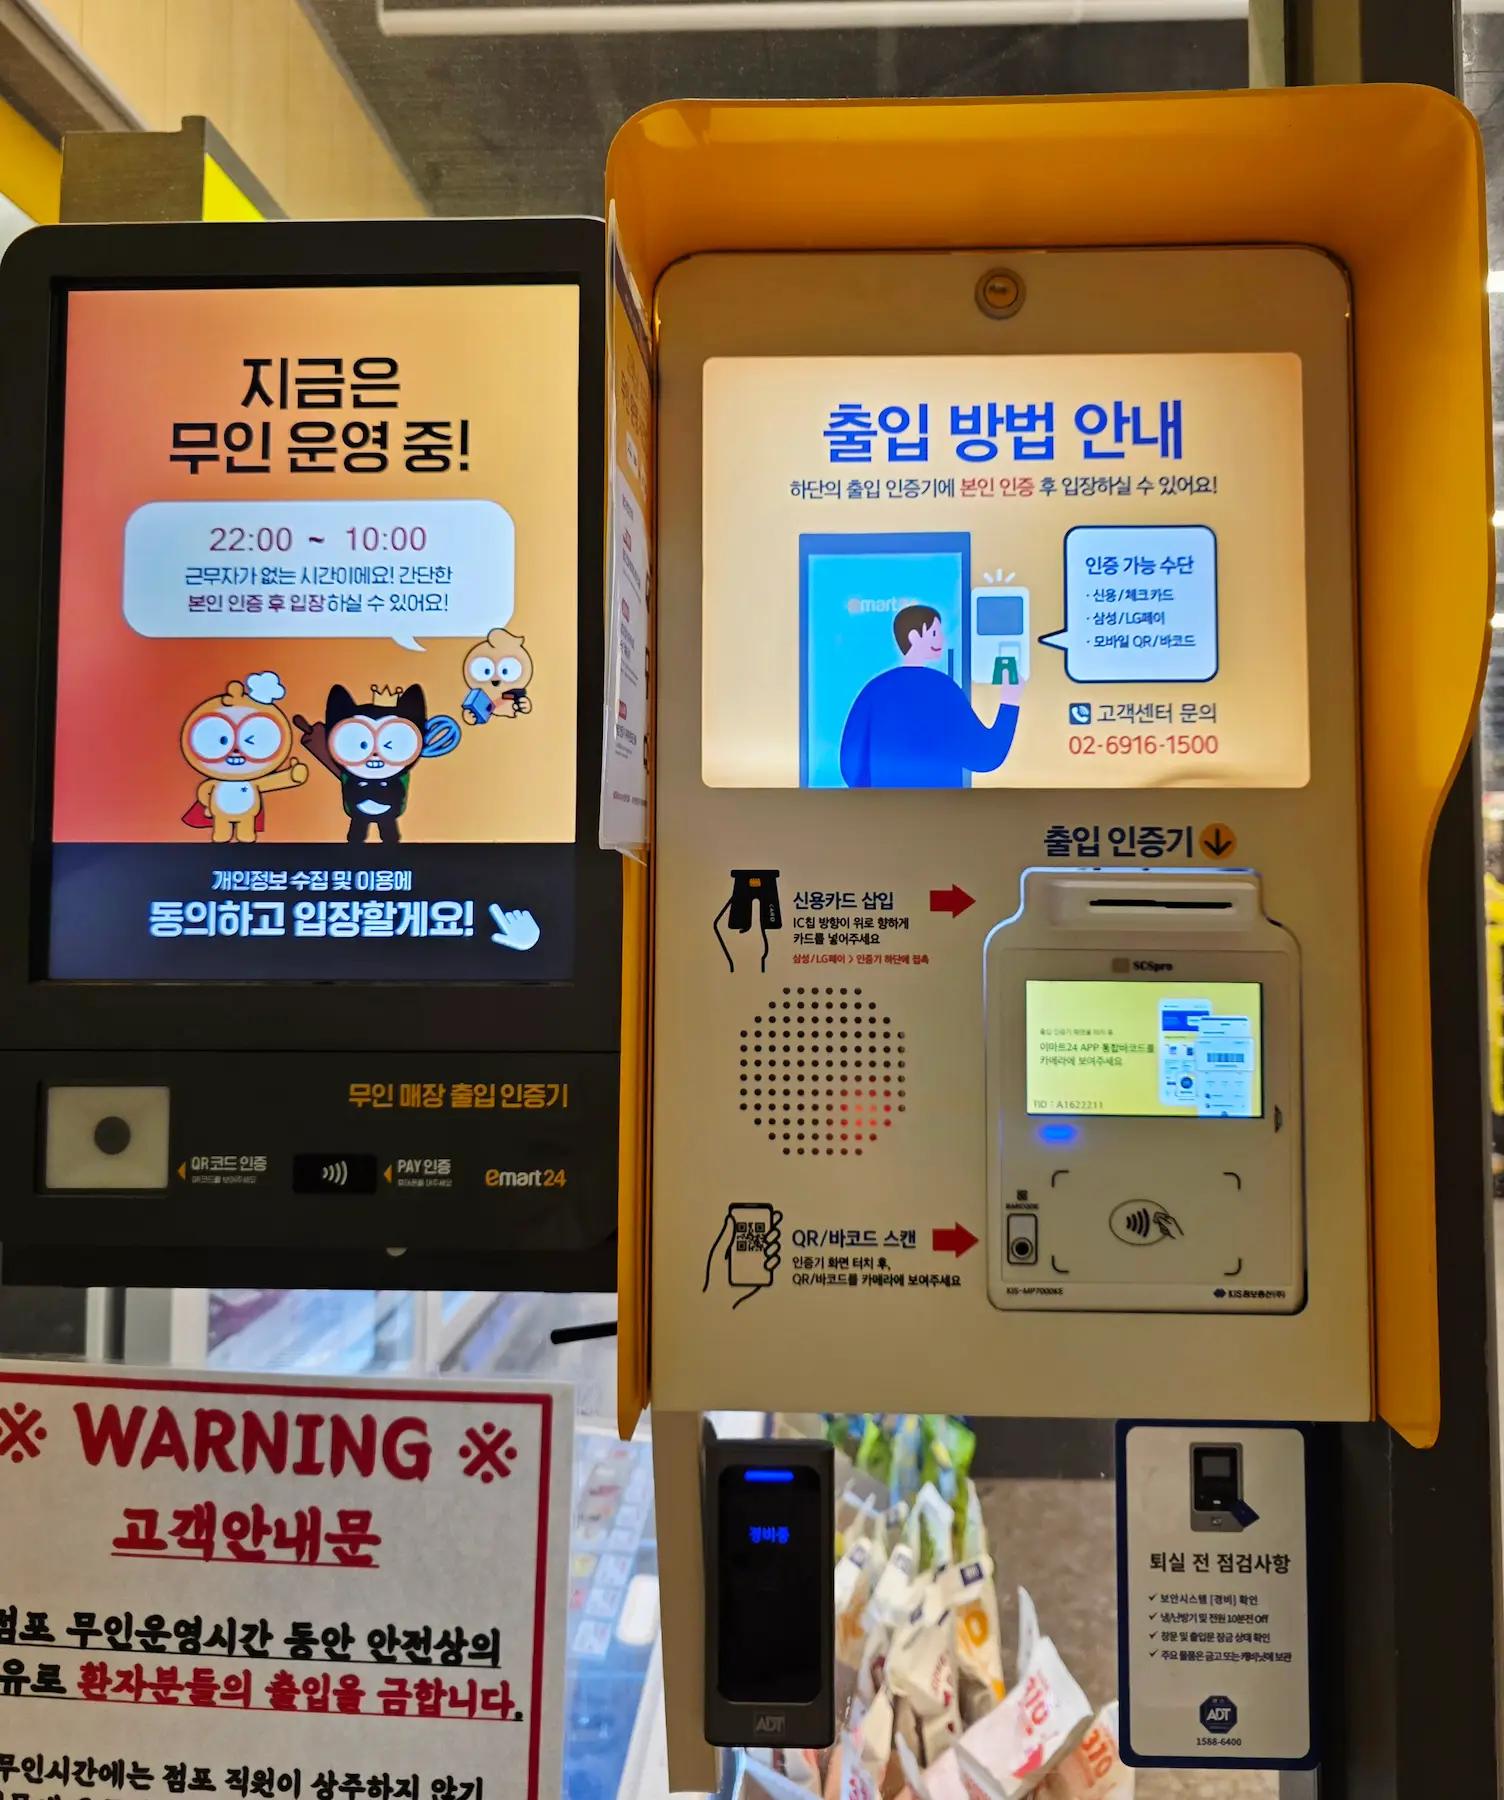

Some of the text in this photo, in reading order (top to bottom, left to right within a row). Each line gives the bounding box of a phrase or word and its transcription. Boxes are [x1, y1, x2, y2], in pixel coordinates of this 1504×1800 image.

[241, 357, 400, 410] 지금은
[823, 399, 1184, 463] 출입 방법 안내
[169, 419, 470, 474] 무인 운영 중!
[790, 475, 1218, 500] 하단의 출입 인증기에 본인 인증 후 입장하실 수 있어요!
[209, 527, 293, 552] 22:00
[345, 526, 427, 551] 10:00
[185, 565, 453, 586] 근무자가 없는 시간이에요! 간단한
[1085, 555, 1195, 575] 인증 가능 수단
[188, 593, 449, 614] 본인 인증 후 입장하실 수 있어요!
[1093, 635, 1129, 649] 모바일
[1097, 702, 1217, 725] 고객센터 문의
[1068, 734, 1219, 757] 02-6916-1500
[1044, 825, 1193, 858] 출입 인증기
[212, 870, 412, 892] 개인정보 수집 및 이용에
[793, 891, 894, 910] 신용카드 삽입
[149, 900, 475, 938] 동의하고 입장할게요!
[793, 917, 909, 930] IC칩 방향이 위로 향하게
[793, 933, 880, 946] 카드를 넣어주세요
[1080, 1043, 1100, 1052] APP
[349, 1083, 569, 1109] 무인 매장 출입 인증기
[191, 1155, 268, 1172] QR코드 인증
[398, 1158, 451, 1176] PAY 인증
[792, 1229, 917, 1249] QR/바코드 스캔
[792, 1256, 891, 1271] 인증기 화면 터치 후,
[792, 1273, 962, 1287] QR/바코드를 카메라에 보여주세요
[73, 1401, 432, 1483] WARNING
[112, 1502, 381, 1564] 고객안내문
[1149, 1552, 1292, 1574] 퇴실 전 점검사항
[66, 1611, 274, 1658] 무인운영시간
[284, 1622, 356, 1661] 동안
[367, 1624, 501, 1667] 안전상의
[77, 1661, 252, 1708] 환자분들의
[265, 1669, 366, 1714] 출입을
[377, 1677, 523, 1720] 금합니다.
[756, 1715, 785, 1733] ADT
[1205, 1707, 1232, 1721] ADT
[1196, 1737, 1242, 1747] 1588-6400
[0, 1753, 483, 1800] 무인시간에는 점포 직원이 상주하지 않기
